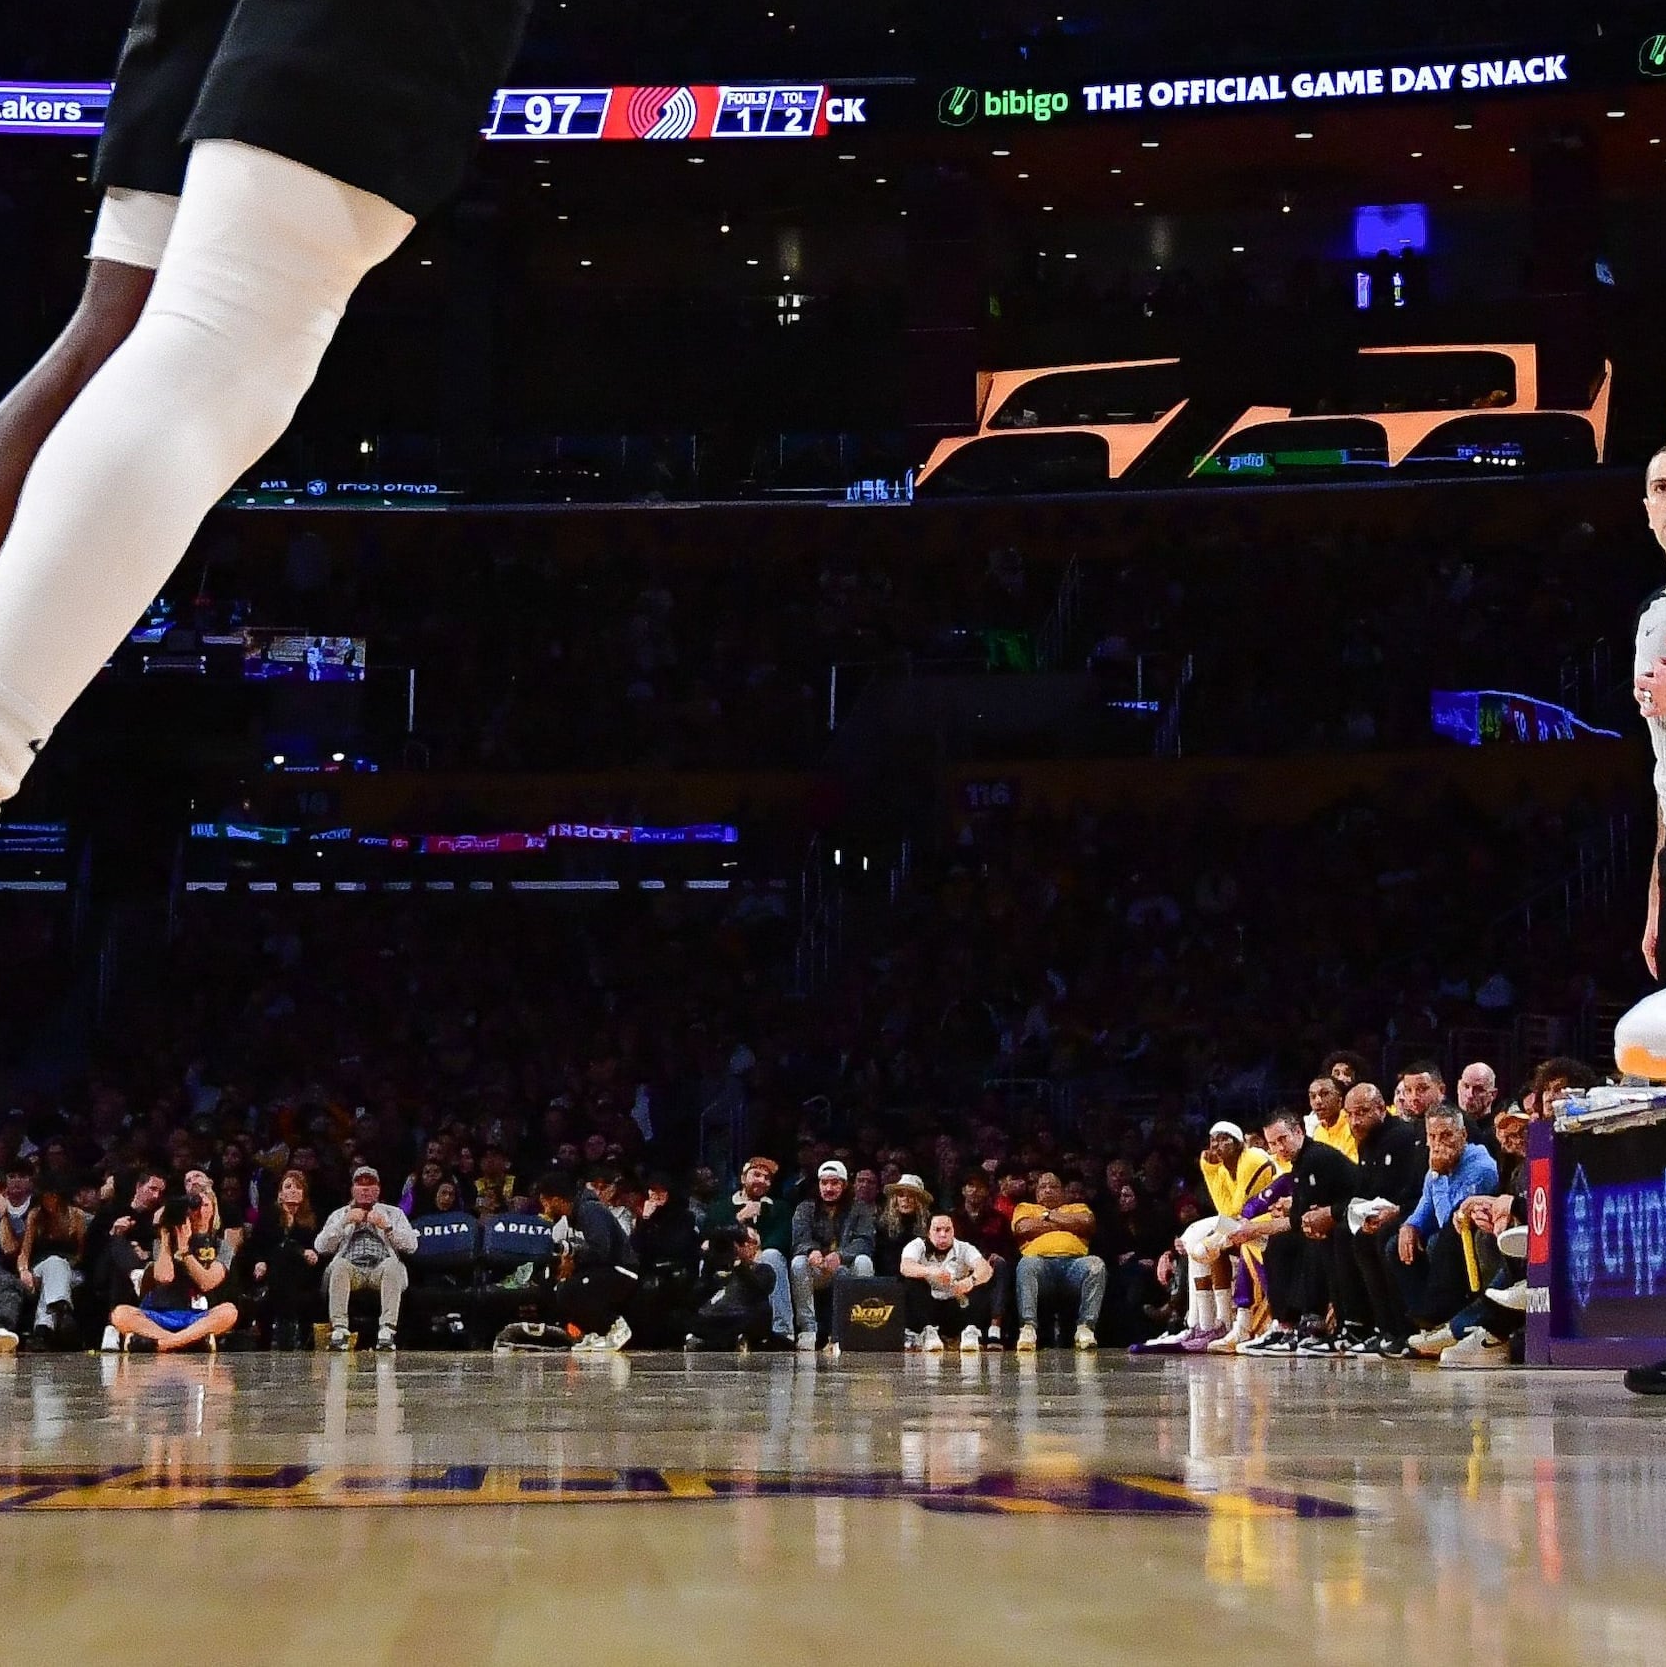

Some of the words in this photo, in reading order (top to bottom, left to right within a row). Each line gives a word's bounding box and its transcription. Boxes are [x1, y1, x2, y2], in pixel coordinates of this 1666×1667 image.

[1083, 84, 1142, 110] THE
[1148, 75, 1287, 106] OFFICIAL
[1291, 69, 1384, 98] GAME
[1391, 65, 1456, 92] DAY
[1461, 55, 1567, 88] SNACK
[726, 93, 767, 106] FOULS
[781, 92, 806, 105] TOL
[985, 90, 1068, 121] bibigo
[524, 95, 582, 134] 97
[736, 107, 752, 133] 1
[783, 107, 805, 133] 2
[423, 1222, 470, 1237] DELTA
